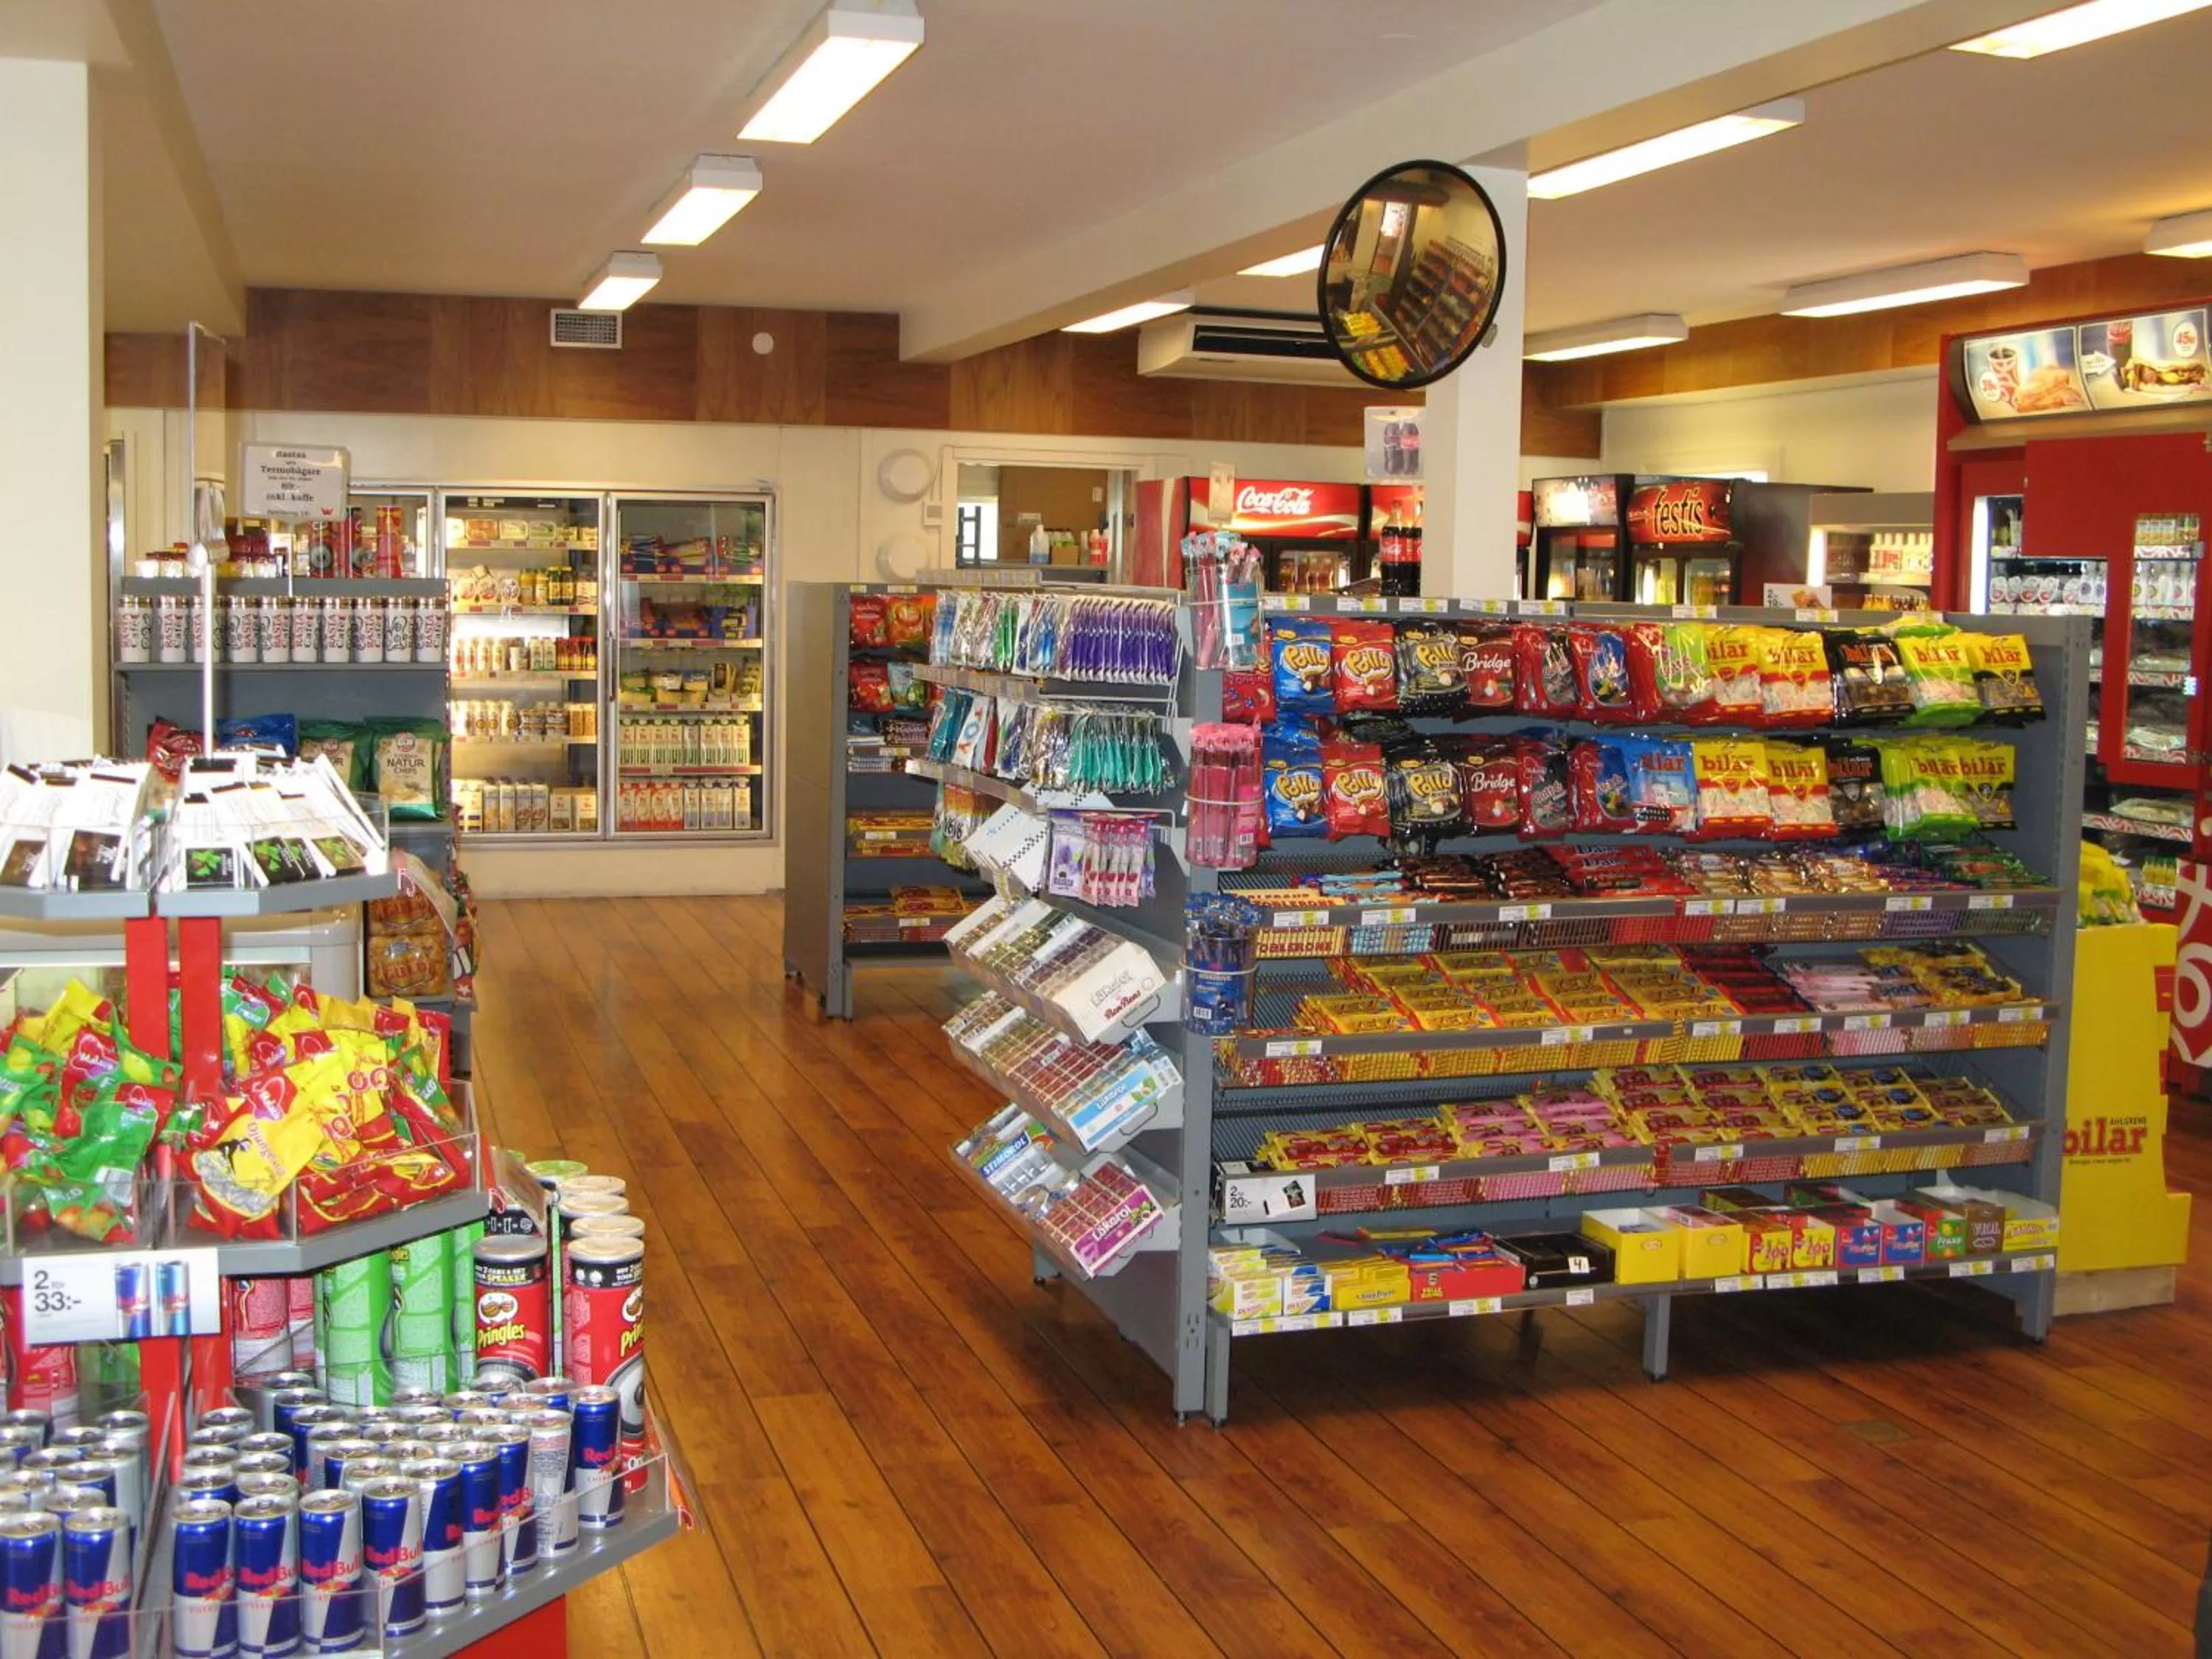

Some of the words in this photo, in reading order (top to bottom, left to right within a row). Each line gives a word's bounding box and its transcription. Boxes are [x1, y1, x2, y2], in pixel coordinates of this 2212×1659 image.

[291, 493, 315, 502] kaffe
[1237, 485, 1315, 515] Coca-Cola
[1652, 487, 1704, 537] festis
[1284, 645, 1329, 677] Polly
[1346, 649, 1393, 680] Polly
[1463, 652, 1512, 673] Bridge
[1980, 645, 2022, 664] bilar
[387, 758, 425, 768] NATUR
[1918, 759, 1959, 775] bilar
[1959, 756, 2006, 775] bilar
[1335, 772, 1382, 801] Polly
[1471, 772, 1517, 794] Bridge
[1257, 942, 1332, 953] OBLERONE
[982, 1135, 1028, 1175] STIMOROL
[1230, 1186, 1237, 1196] 2
[1229, 1199, 1252, 1208] 20:-
[34, 1270, 49, 1290] 2
[487, 1273, 527, 1283] SPEAKER
[34, 1290, 83, 1312] 33:-
[478, 1322, 525, 1351] Pringles
[400, 1537, 424, 1560] Bull
[336, 1552, 360, 1576] Bull
[186, 1569, 225, 1589] Red
[240, 1566, 276, 1585] Red
